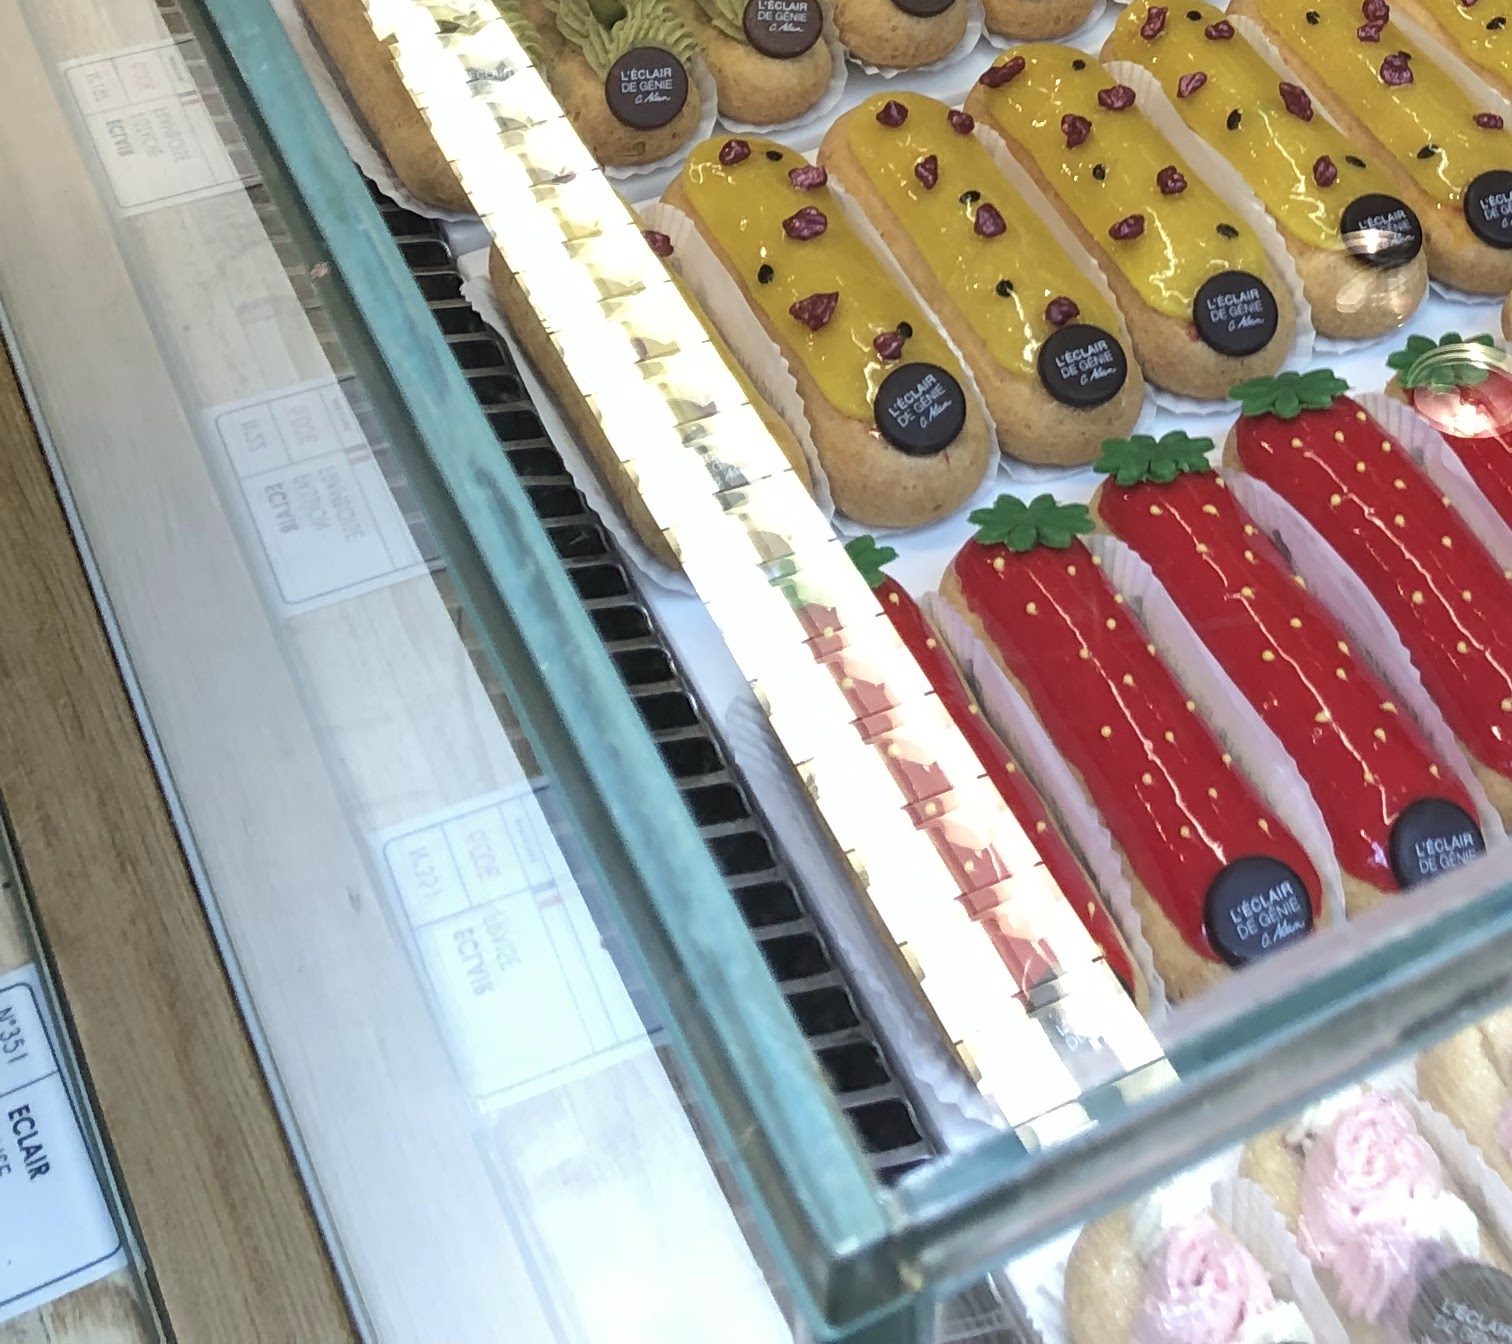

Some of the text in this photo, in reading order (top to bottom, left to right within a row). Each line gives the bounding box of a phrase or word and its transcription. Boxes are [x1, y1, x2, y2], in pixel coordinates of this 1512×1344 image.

[758, 0, 807, 12] L'ÉCLAIR
[757, 11, 772, 20] DE
[621, 67, 672, 81] L'ÉCLAIR
[621, 83, 637, 93] DE
[1483, 208, 1499, 220] DE
[1209, 309, 1227, 321] DE
[1059, 365, 1078, 379] DE
[895, 410, 916, 428] DE
[7, 1103, 51, 1181] ECLAIR
